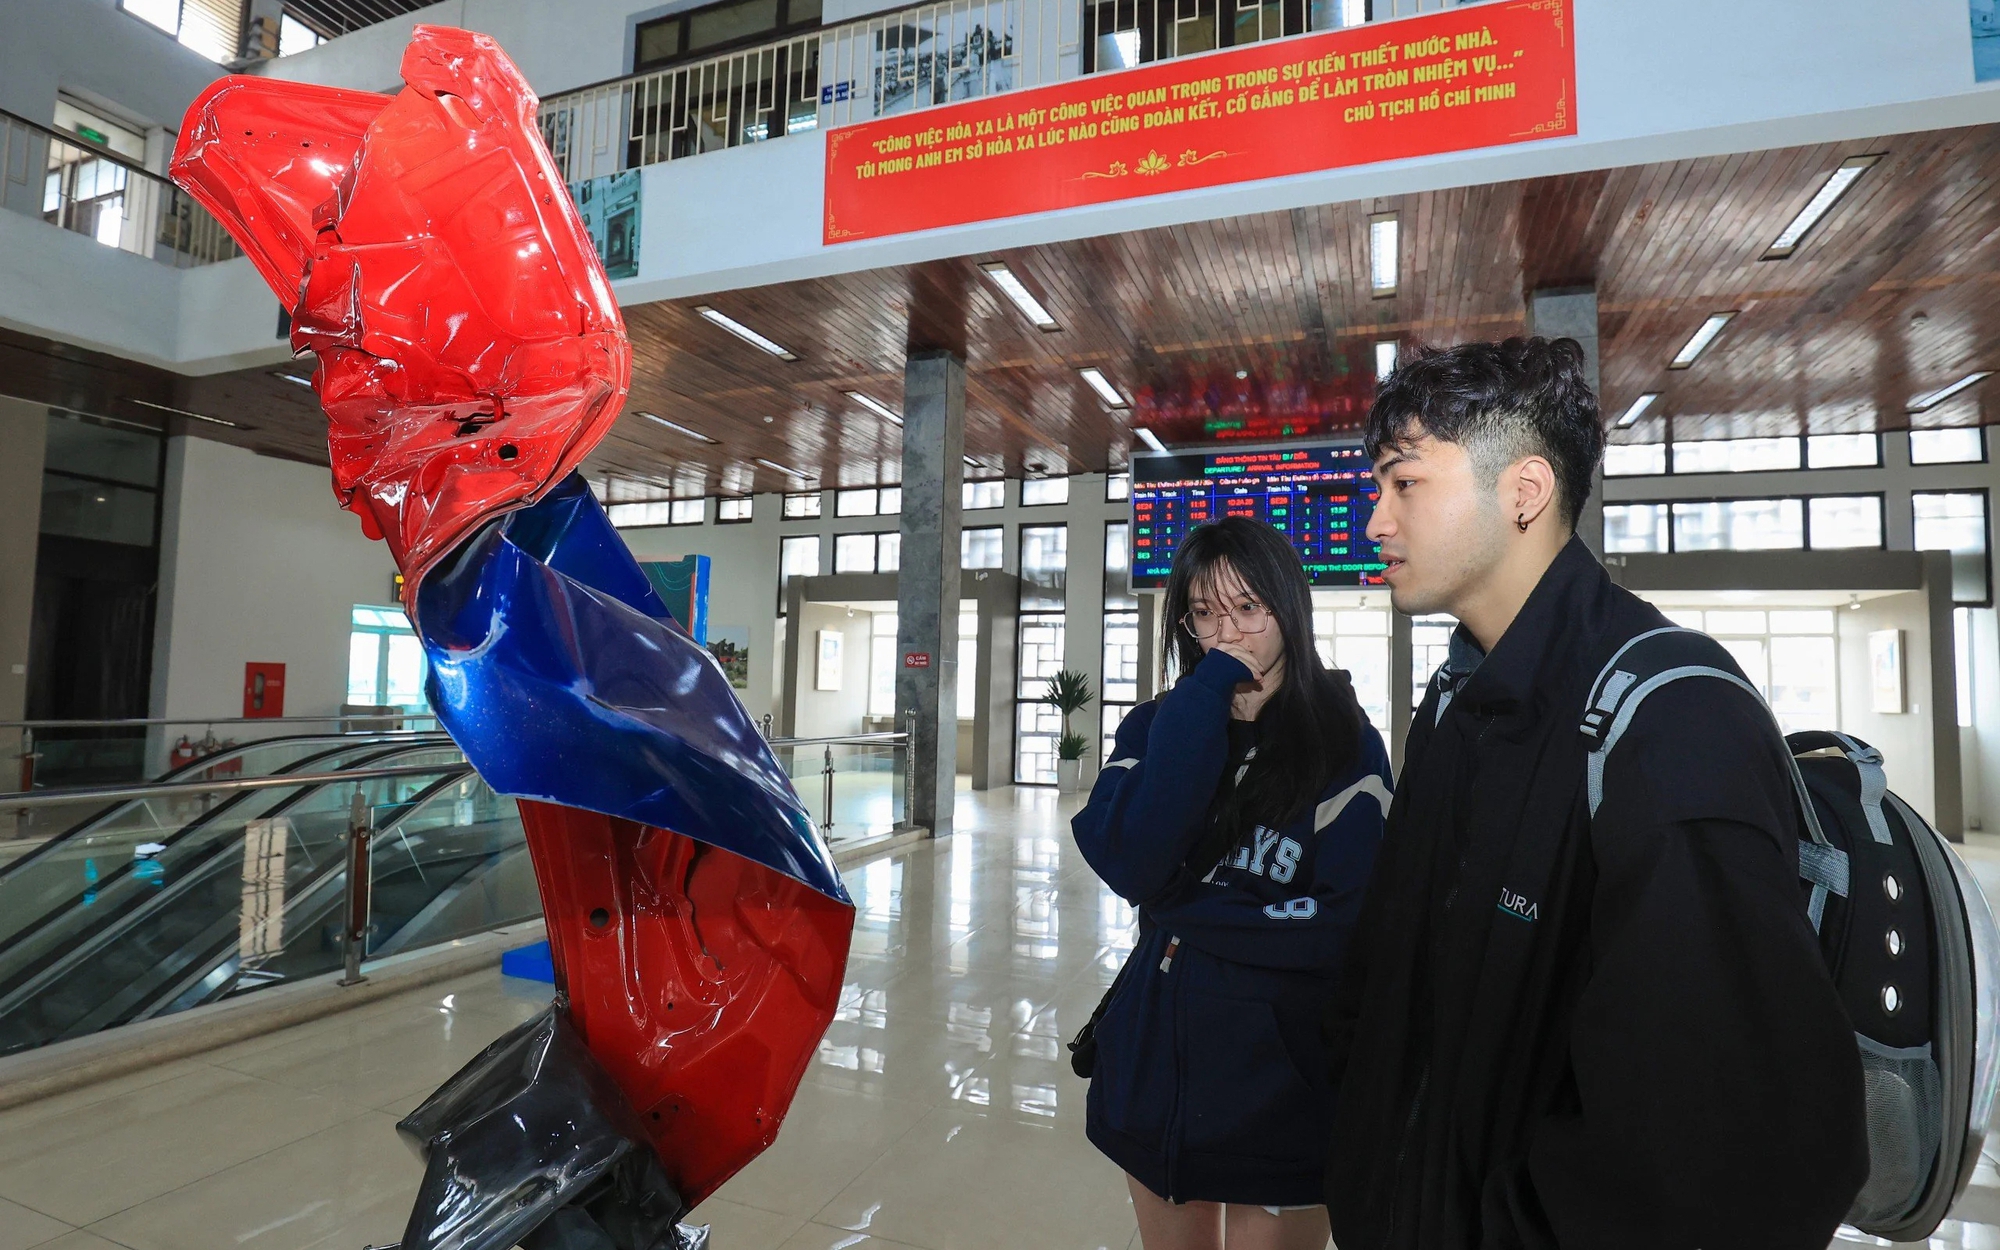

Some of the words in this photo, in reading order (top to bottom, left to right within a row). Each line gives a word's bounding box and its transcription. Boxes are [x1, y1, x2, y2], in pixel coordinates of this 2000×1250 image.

[856, 160, 876, 180] TÔI
[878, 156, 912, 176] MONG
[915, 152, 942, 170] ANH
[945, 147, 963, 164] EM
[966, 141, 983, 160] SỞ
[986, 136, 1013, 157] HỎA
[1016, 135, 1035, 151] XA
[1038, 128, 1065, 147] LÚC
[1068, 121, 1098, 142] NÀO
[1101, 114, 1140, 136] CŨNG
[1144, 106, 1184, 129] ĐOÀN
[1188, 96, 1222, 119] KẾT,
[1226, 90, 1249, 115] CỐ
[1251, 86, 1294, 111] GẮNG
[1298, 76, 1321, 102] ĐỂ
[1324, 77, 1358, 99] LÀM
[1363, 68, 1409, 92] TRÒN
[1413, 58, 1467, 84] NHIỆM
[872, 134, 911, 154] “CÔNG
[915, 128, 943, 149] VIỆC
[946, 121, 972, 141] HỎA
[975, 120, 993, 137] XA
[997, 113, 1014, 132] LÀ
[1018, 108, 1045, 131] MỘT
[1050, 101, 1087, 120] CÔNG
[1091, 93, 1123, 117] VIỆC
[1127, 87, 1167, 108] QUAN
[1171, 78, 1222, 101] TRỌNG
[1226, 67, 1278, 90] TRONG
[1282, 61, 1303, 84] SỰ
[1307, 51, 1346, 77] KIẾN
[1350, 41, 1399, 68] THIẾT
[1404, 36, 1451, 60] NƯỚC
[1455, 26, 1498, 51] NHÀ.
[1344, 100, 1375, 123] CHỦ
[1379, 98, 1414, 121] TỊCH
[1419, 88, 1440, 112] HỒ
[1444, 85, 1470, 107] CHÍ
[1475, 82, 1516, 103] MINH
[1275, 462, 1320, 470] INFORMATION
